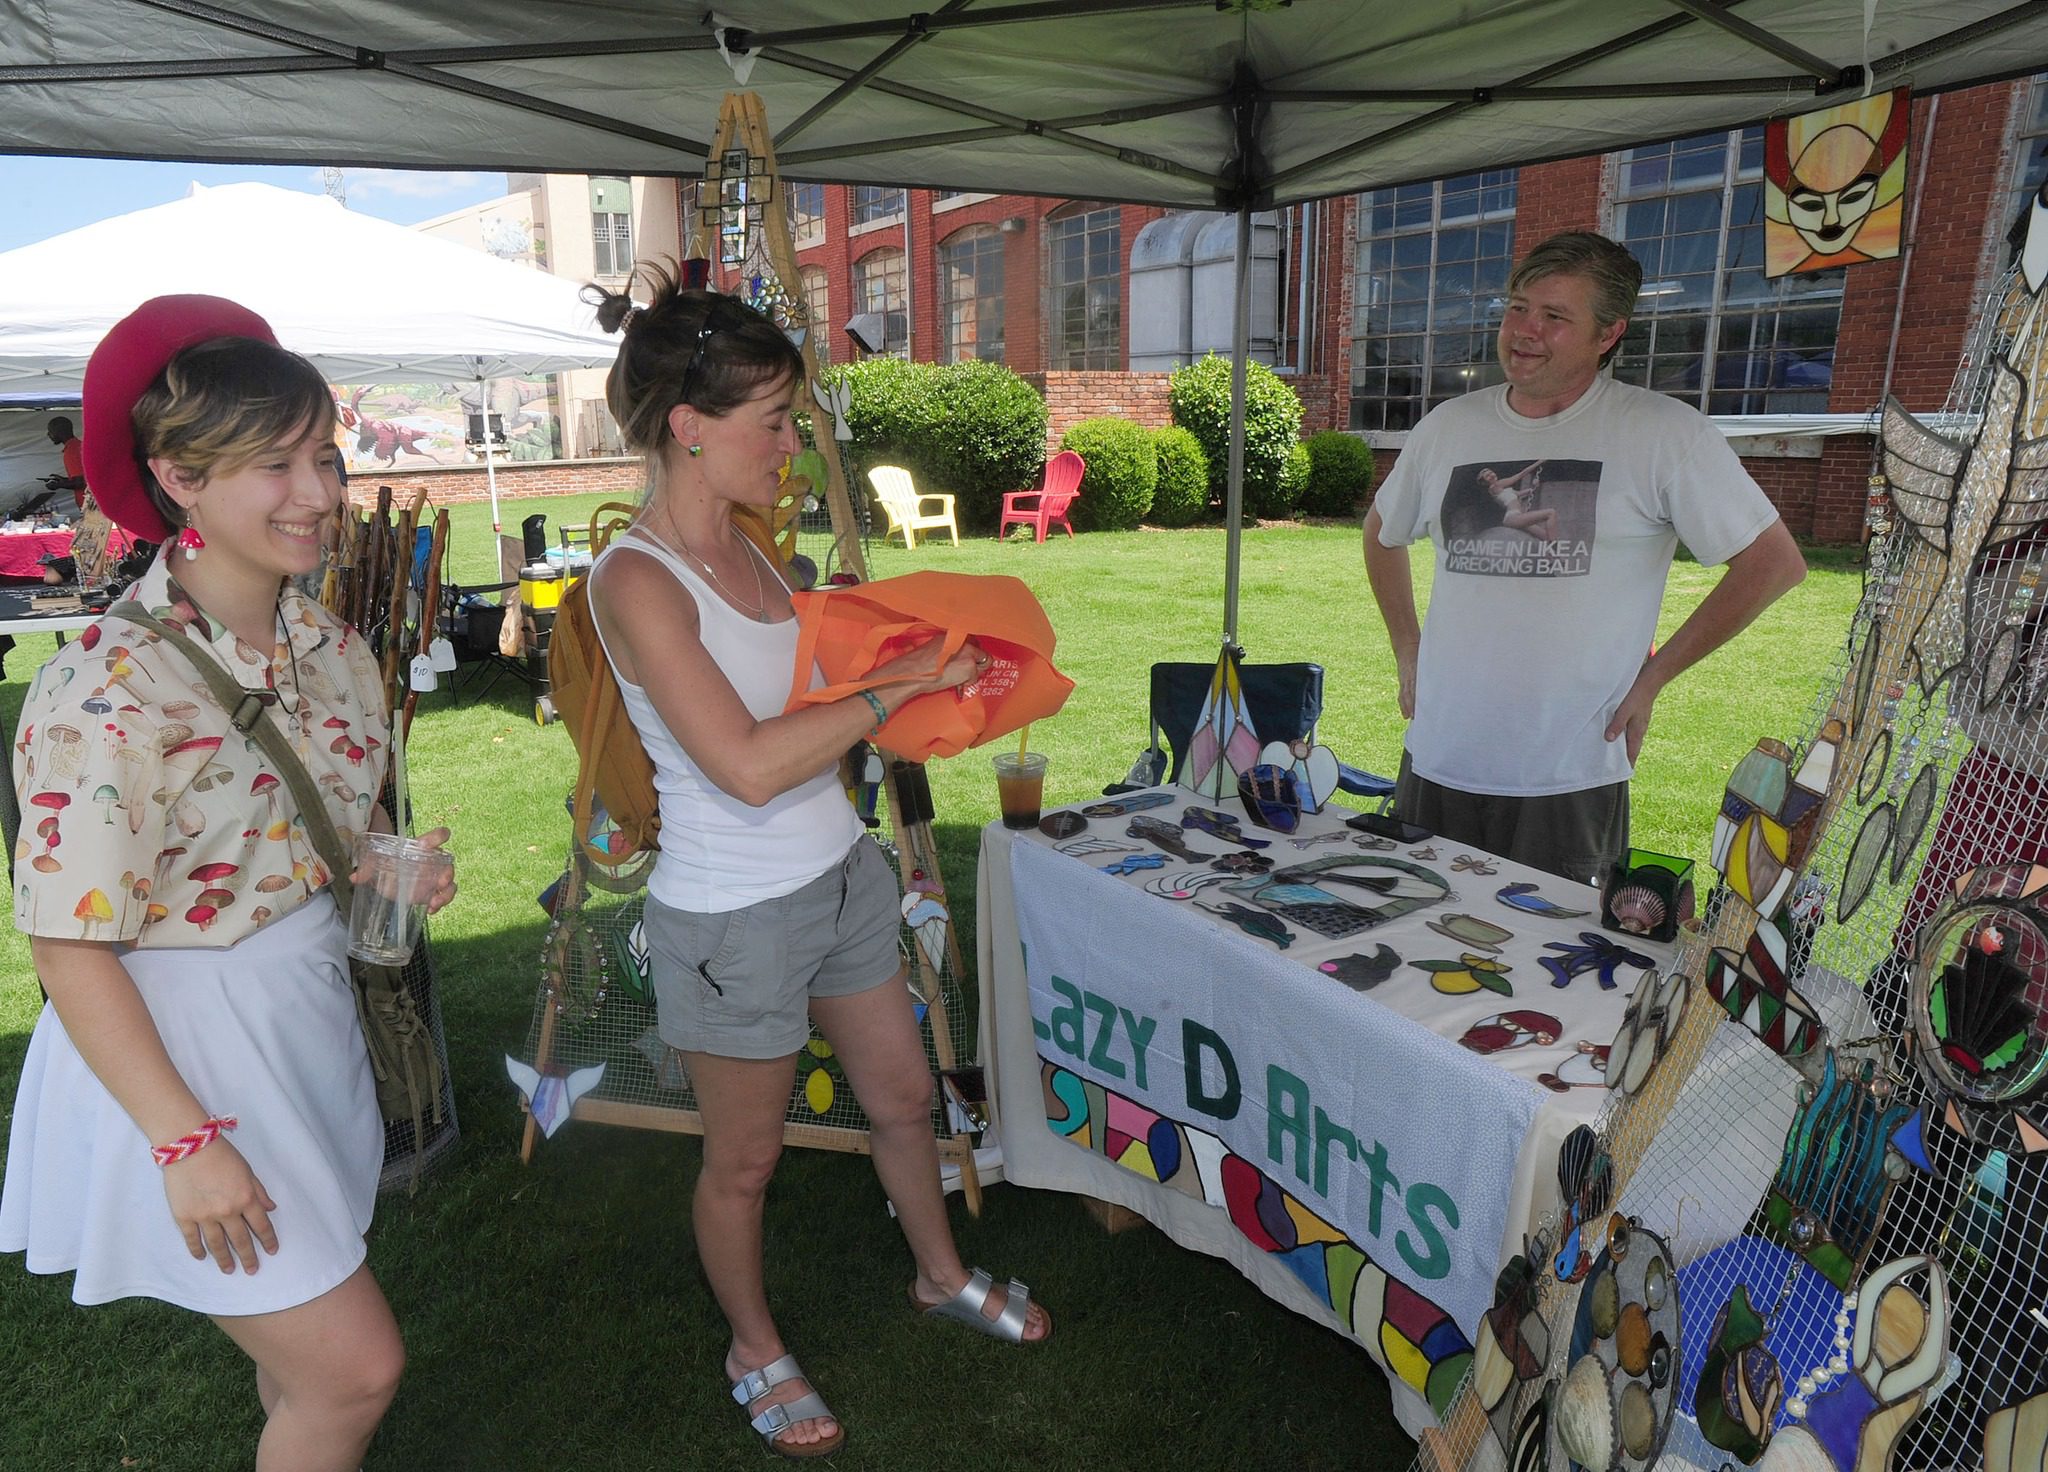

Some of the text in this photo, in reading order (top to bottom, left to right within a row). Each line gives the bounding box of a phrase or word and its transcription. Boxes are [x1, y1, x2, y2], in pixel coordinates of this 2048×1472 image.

[1453, 539, 1503, 556] CAME
[1505, 540, 1526, 556] IN
[1527, 540, 1571, 557] LIKE
[1572, 540, 1589, 557] A
[1448, 554, 1587, 575] WRECKING BALL
[1182, 1018, 1242, 1121] D
